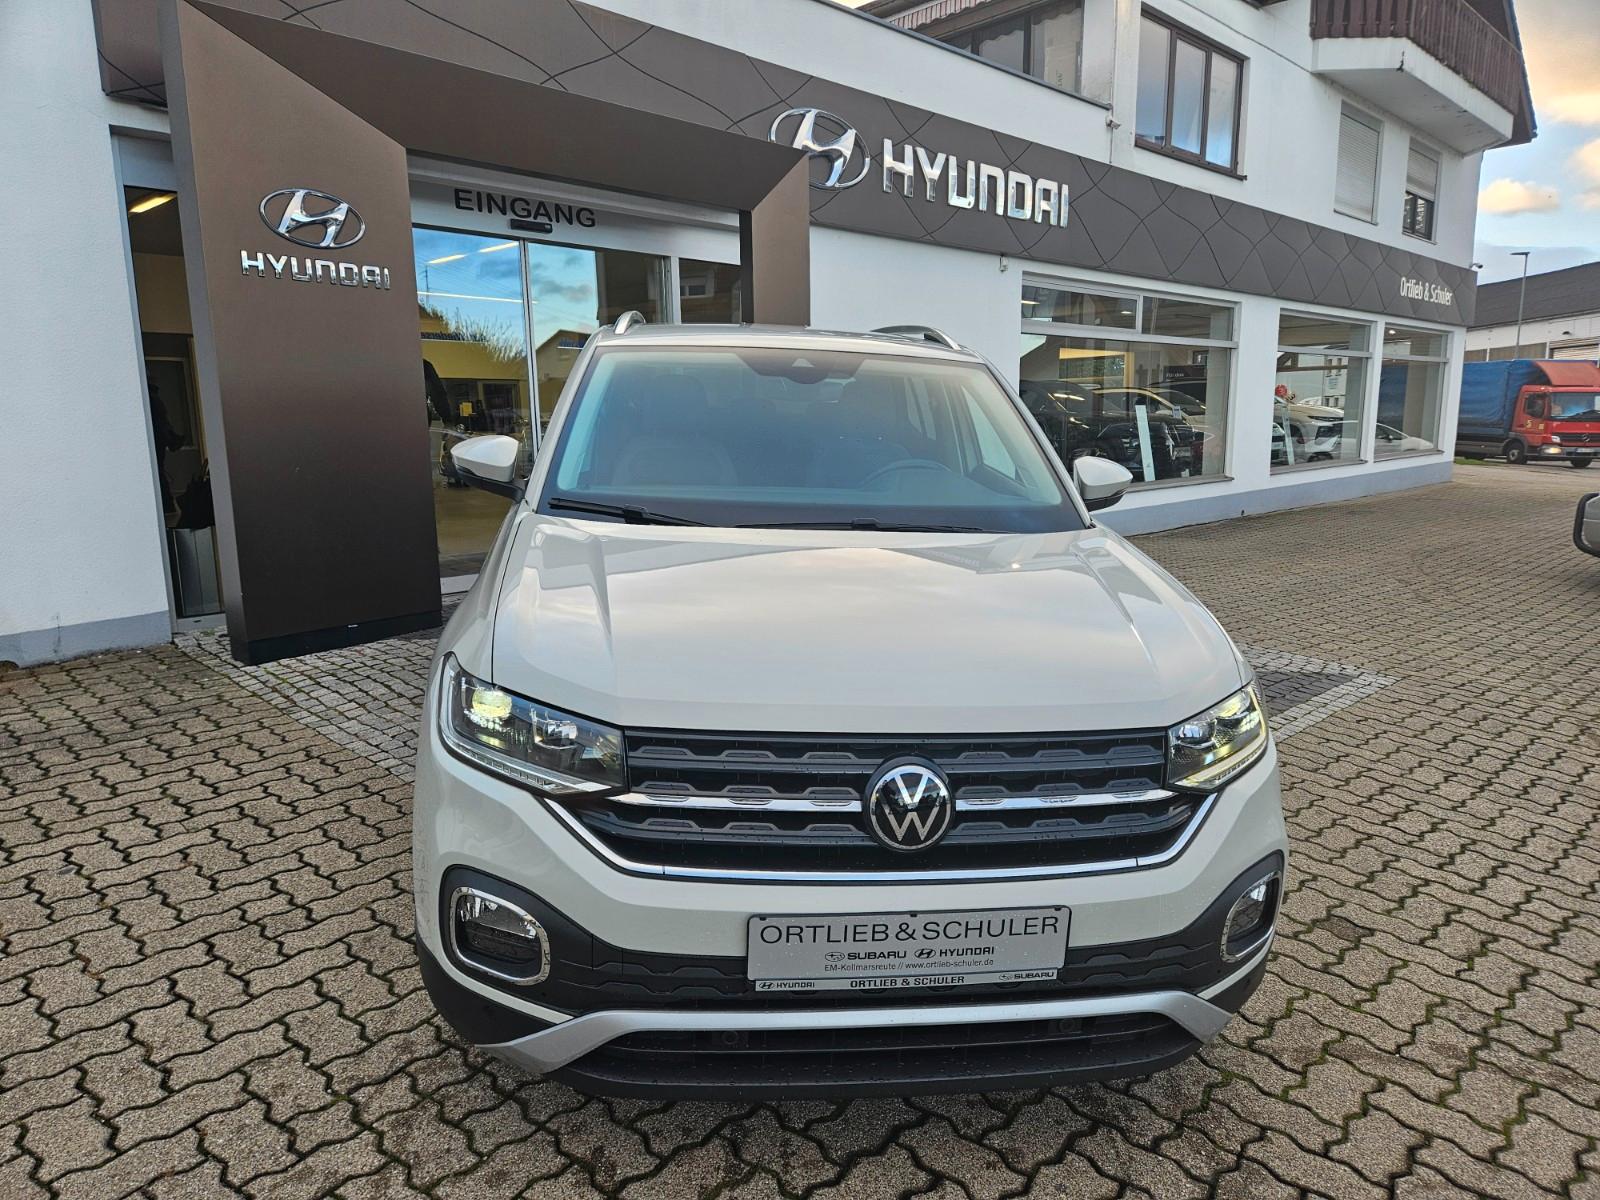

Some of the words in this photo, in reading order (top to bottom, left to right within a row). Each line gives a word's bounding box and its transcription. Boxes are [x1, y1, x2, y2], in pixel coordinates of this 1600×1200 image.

[882, 137, 1069, 229] HYUNDAI
[454, 188, 596, 228] EINGANG
[240, 250, 391, 290] HYUNDAI
[1400, 276, 1424, 300] Ortlieb
[1424, 282, 1430, 301] &
[847, 950, 907, 960] SUBARU
[939, 946, 995, 957] HYUNDAI
[824, 961, 896, 972] EM-Kollmarsreute
[776, 981, 815, 989] HYUNDAI
[850, 978, 898, 988] ORTLIEB
[901, 978, 910, 986] &
[913, 975, 965, 986] SCHULER
[1014, 971, 1055, 980] SUBARU
